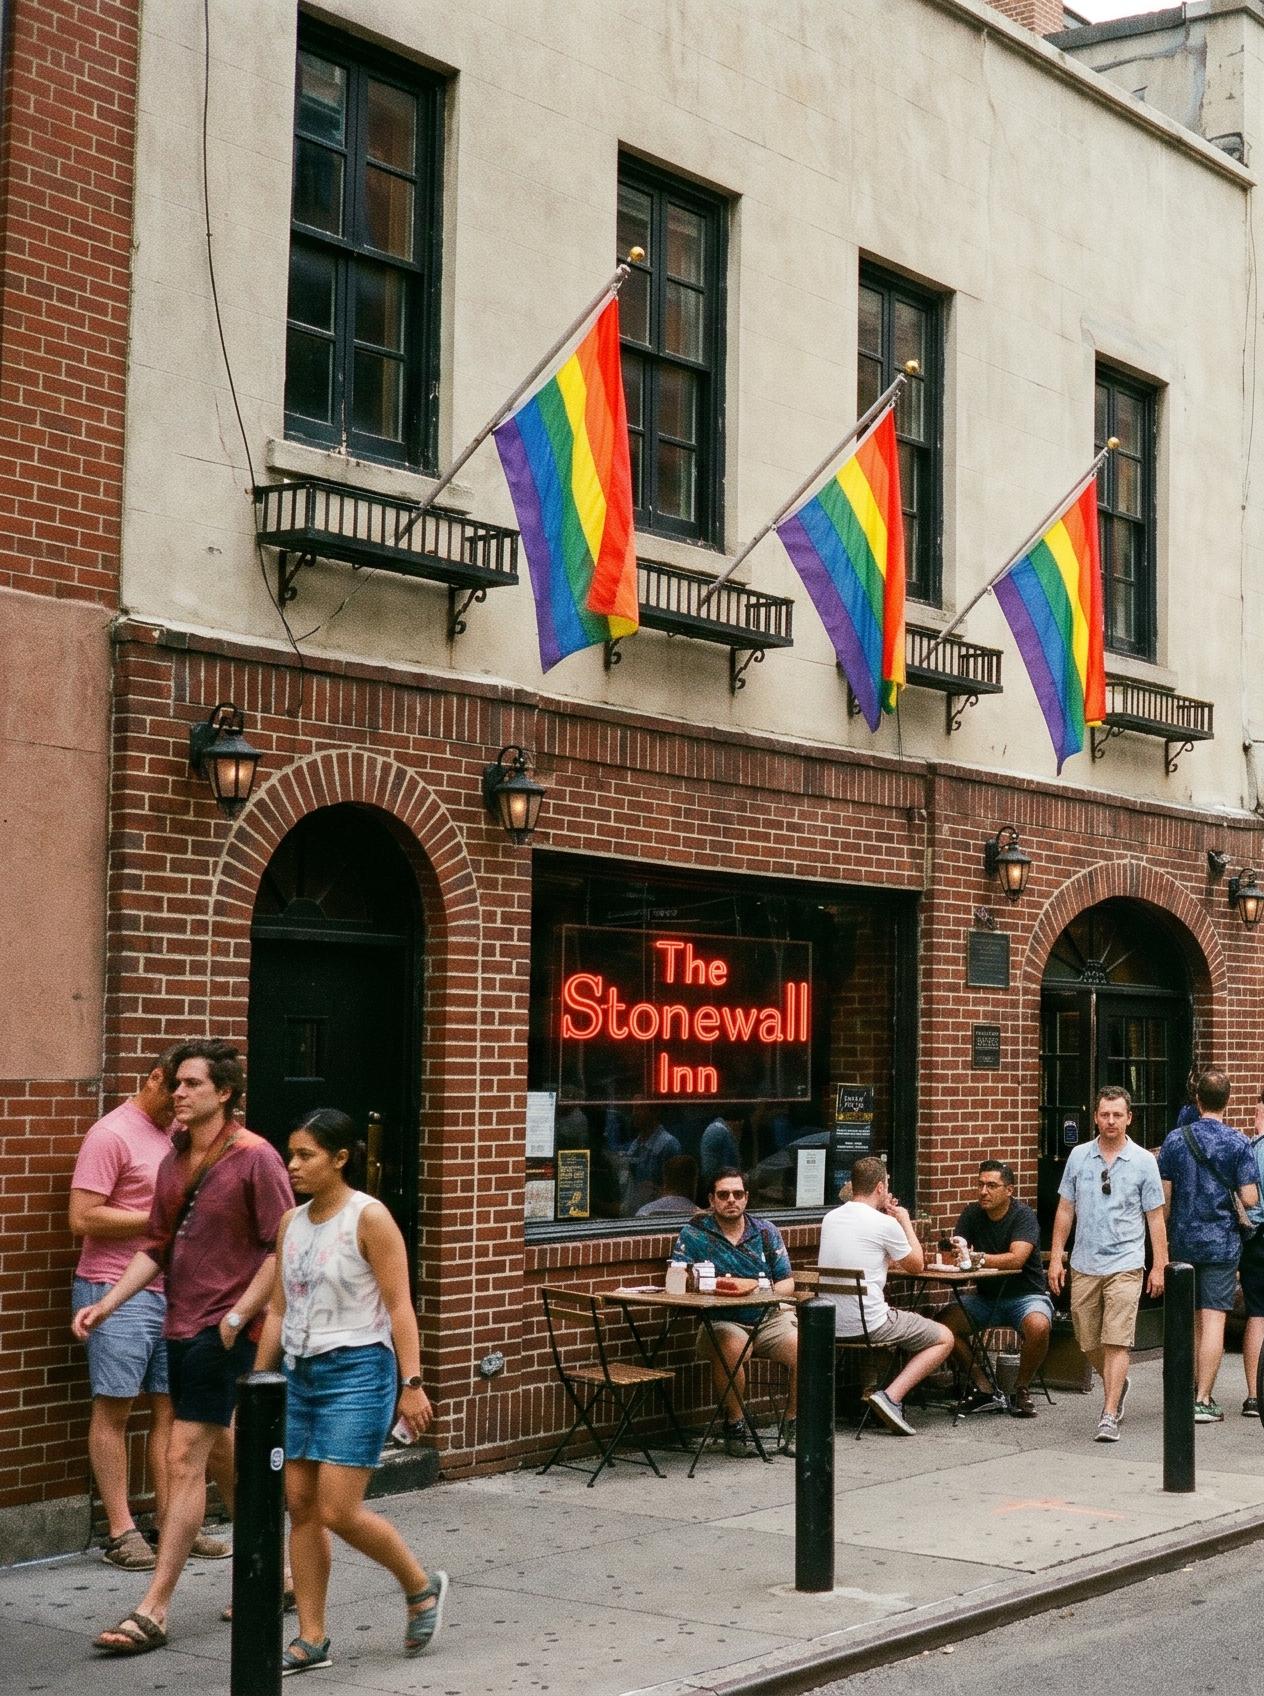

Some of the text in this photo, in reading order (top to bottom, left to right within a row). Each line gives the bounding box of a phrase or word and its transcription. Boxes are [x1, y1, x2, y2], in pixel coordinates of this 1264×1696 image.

[656, 941, 727, 986] The
[563, 973, 808, 1042] Stonewall
[660, 1052, 717, 1093] Inn
